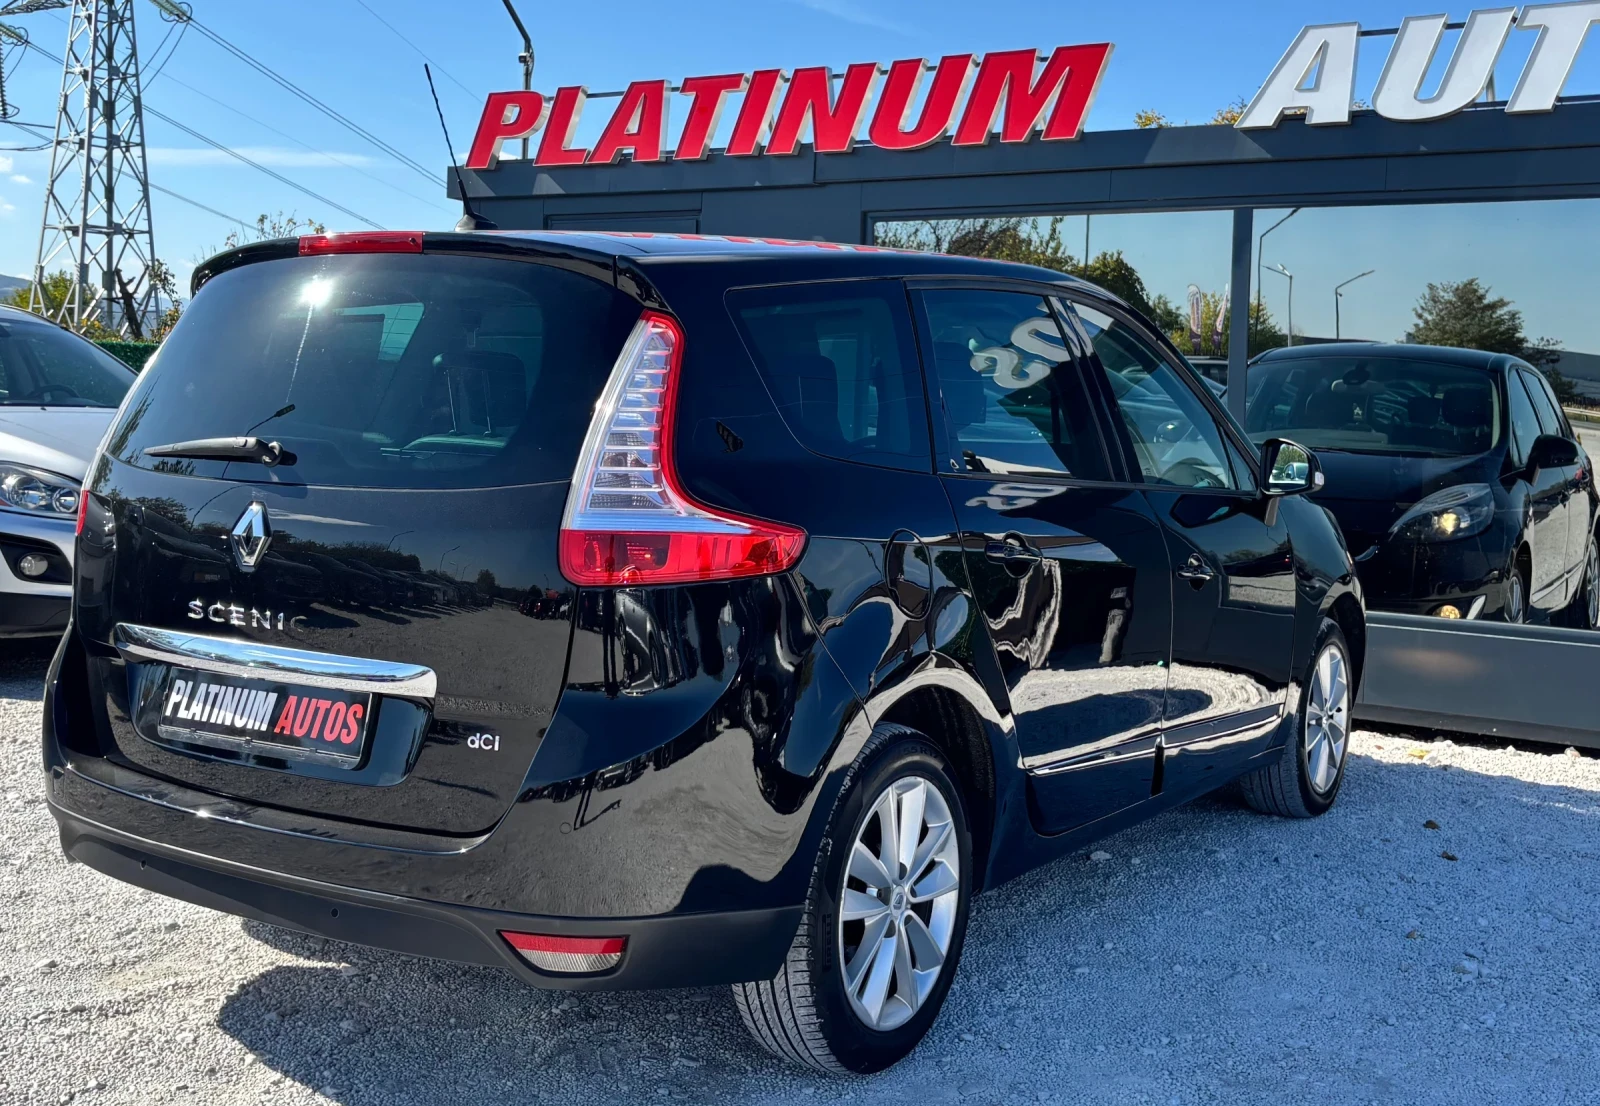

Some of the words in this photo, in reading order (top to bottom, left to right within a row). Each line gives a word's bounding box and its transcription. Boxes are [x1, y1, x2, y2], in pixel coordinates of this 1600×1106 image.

[465, 42, 1115, 170] PLATINUM
[1233, 1, 1600, 130] AUT
[188, 599, 307, 632] SCENIC
[165, 679, 278, 731] PLATINUM
[274, 695, 363, 744] AUTOS
